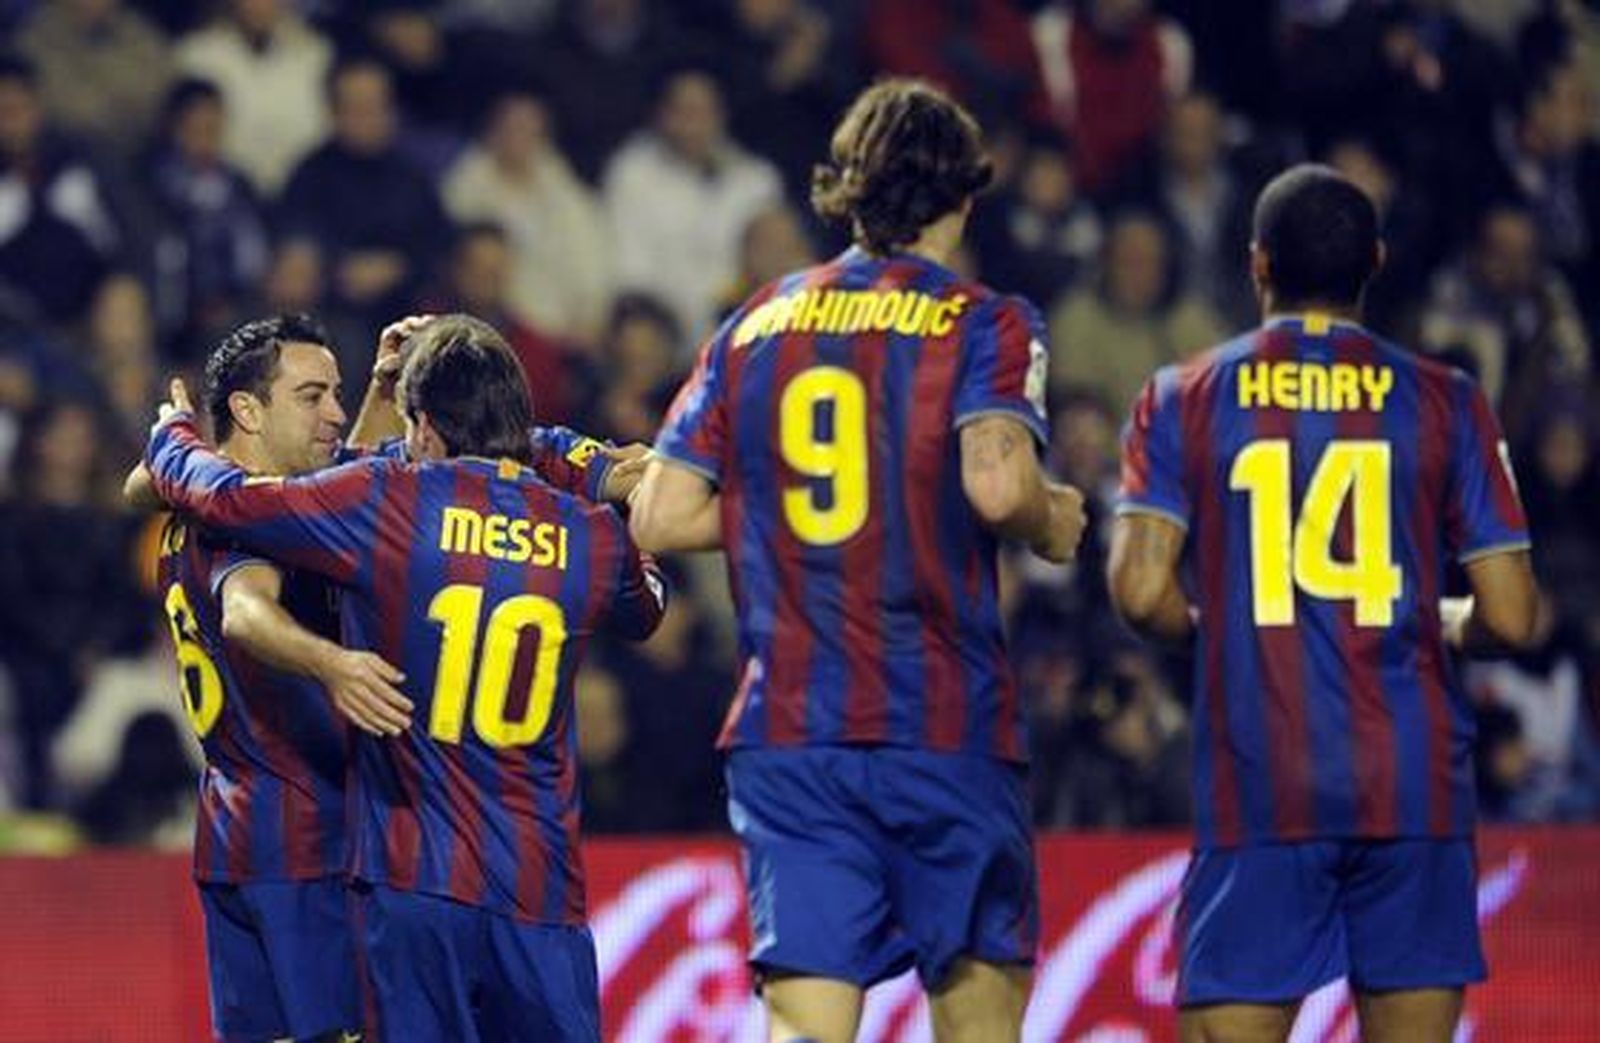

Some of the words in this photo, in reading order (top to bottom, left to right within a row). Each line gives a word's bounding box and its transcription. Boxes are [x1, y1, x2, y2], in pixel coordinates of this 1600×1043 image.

[780, 366, 869, 546] 9
[1238, 361, 1393, 412] HENRY
[440, 506, 568, 570] MESSI
[1230, 439, 1403, 627] 14
[428, 583, 566, 747] 10
